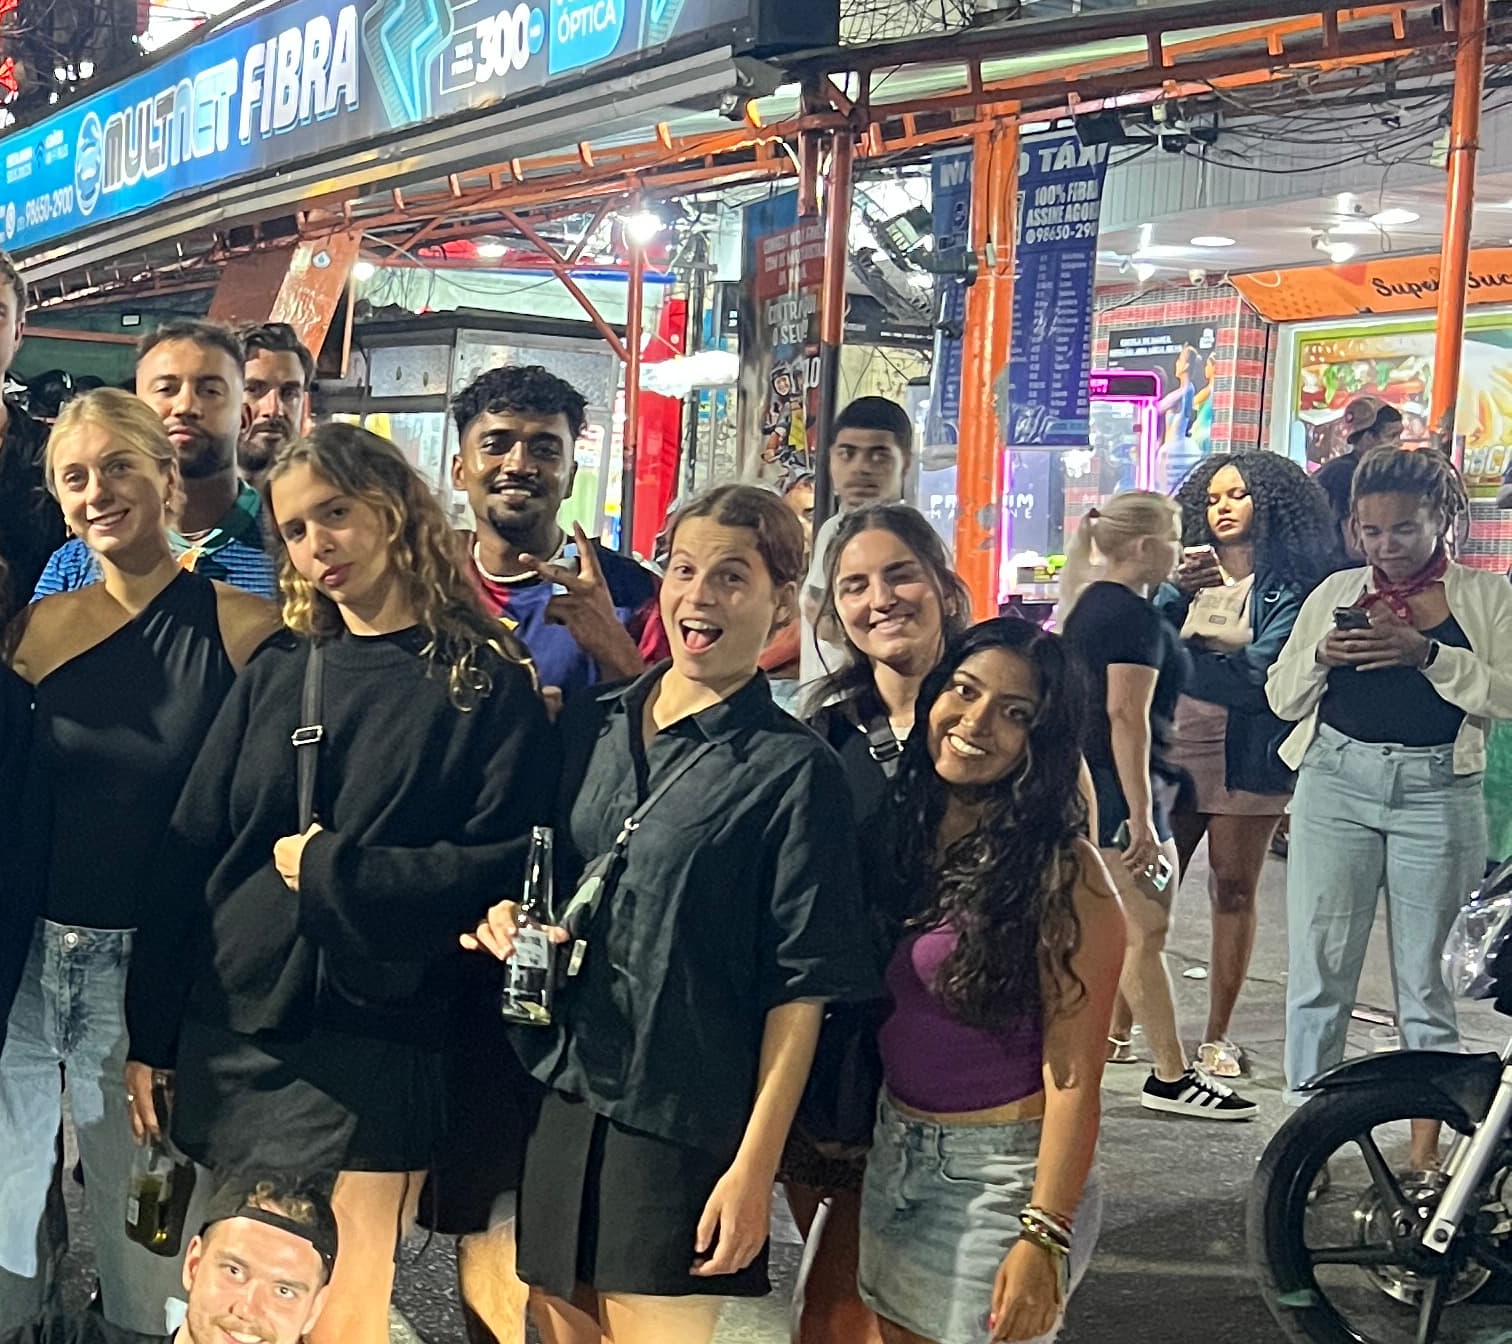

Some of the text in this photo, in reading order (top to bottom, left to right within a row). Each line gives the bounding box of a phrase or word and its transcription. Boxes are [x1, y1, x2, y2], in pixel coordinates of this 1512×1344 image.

[475, 3, 531, 82] 300
[103, 5, 358, 192] MULTNET FIBRA
[1372, 276, 1440, 299] Supe
